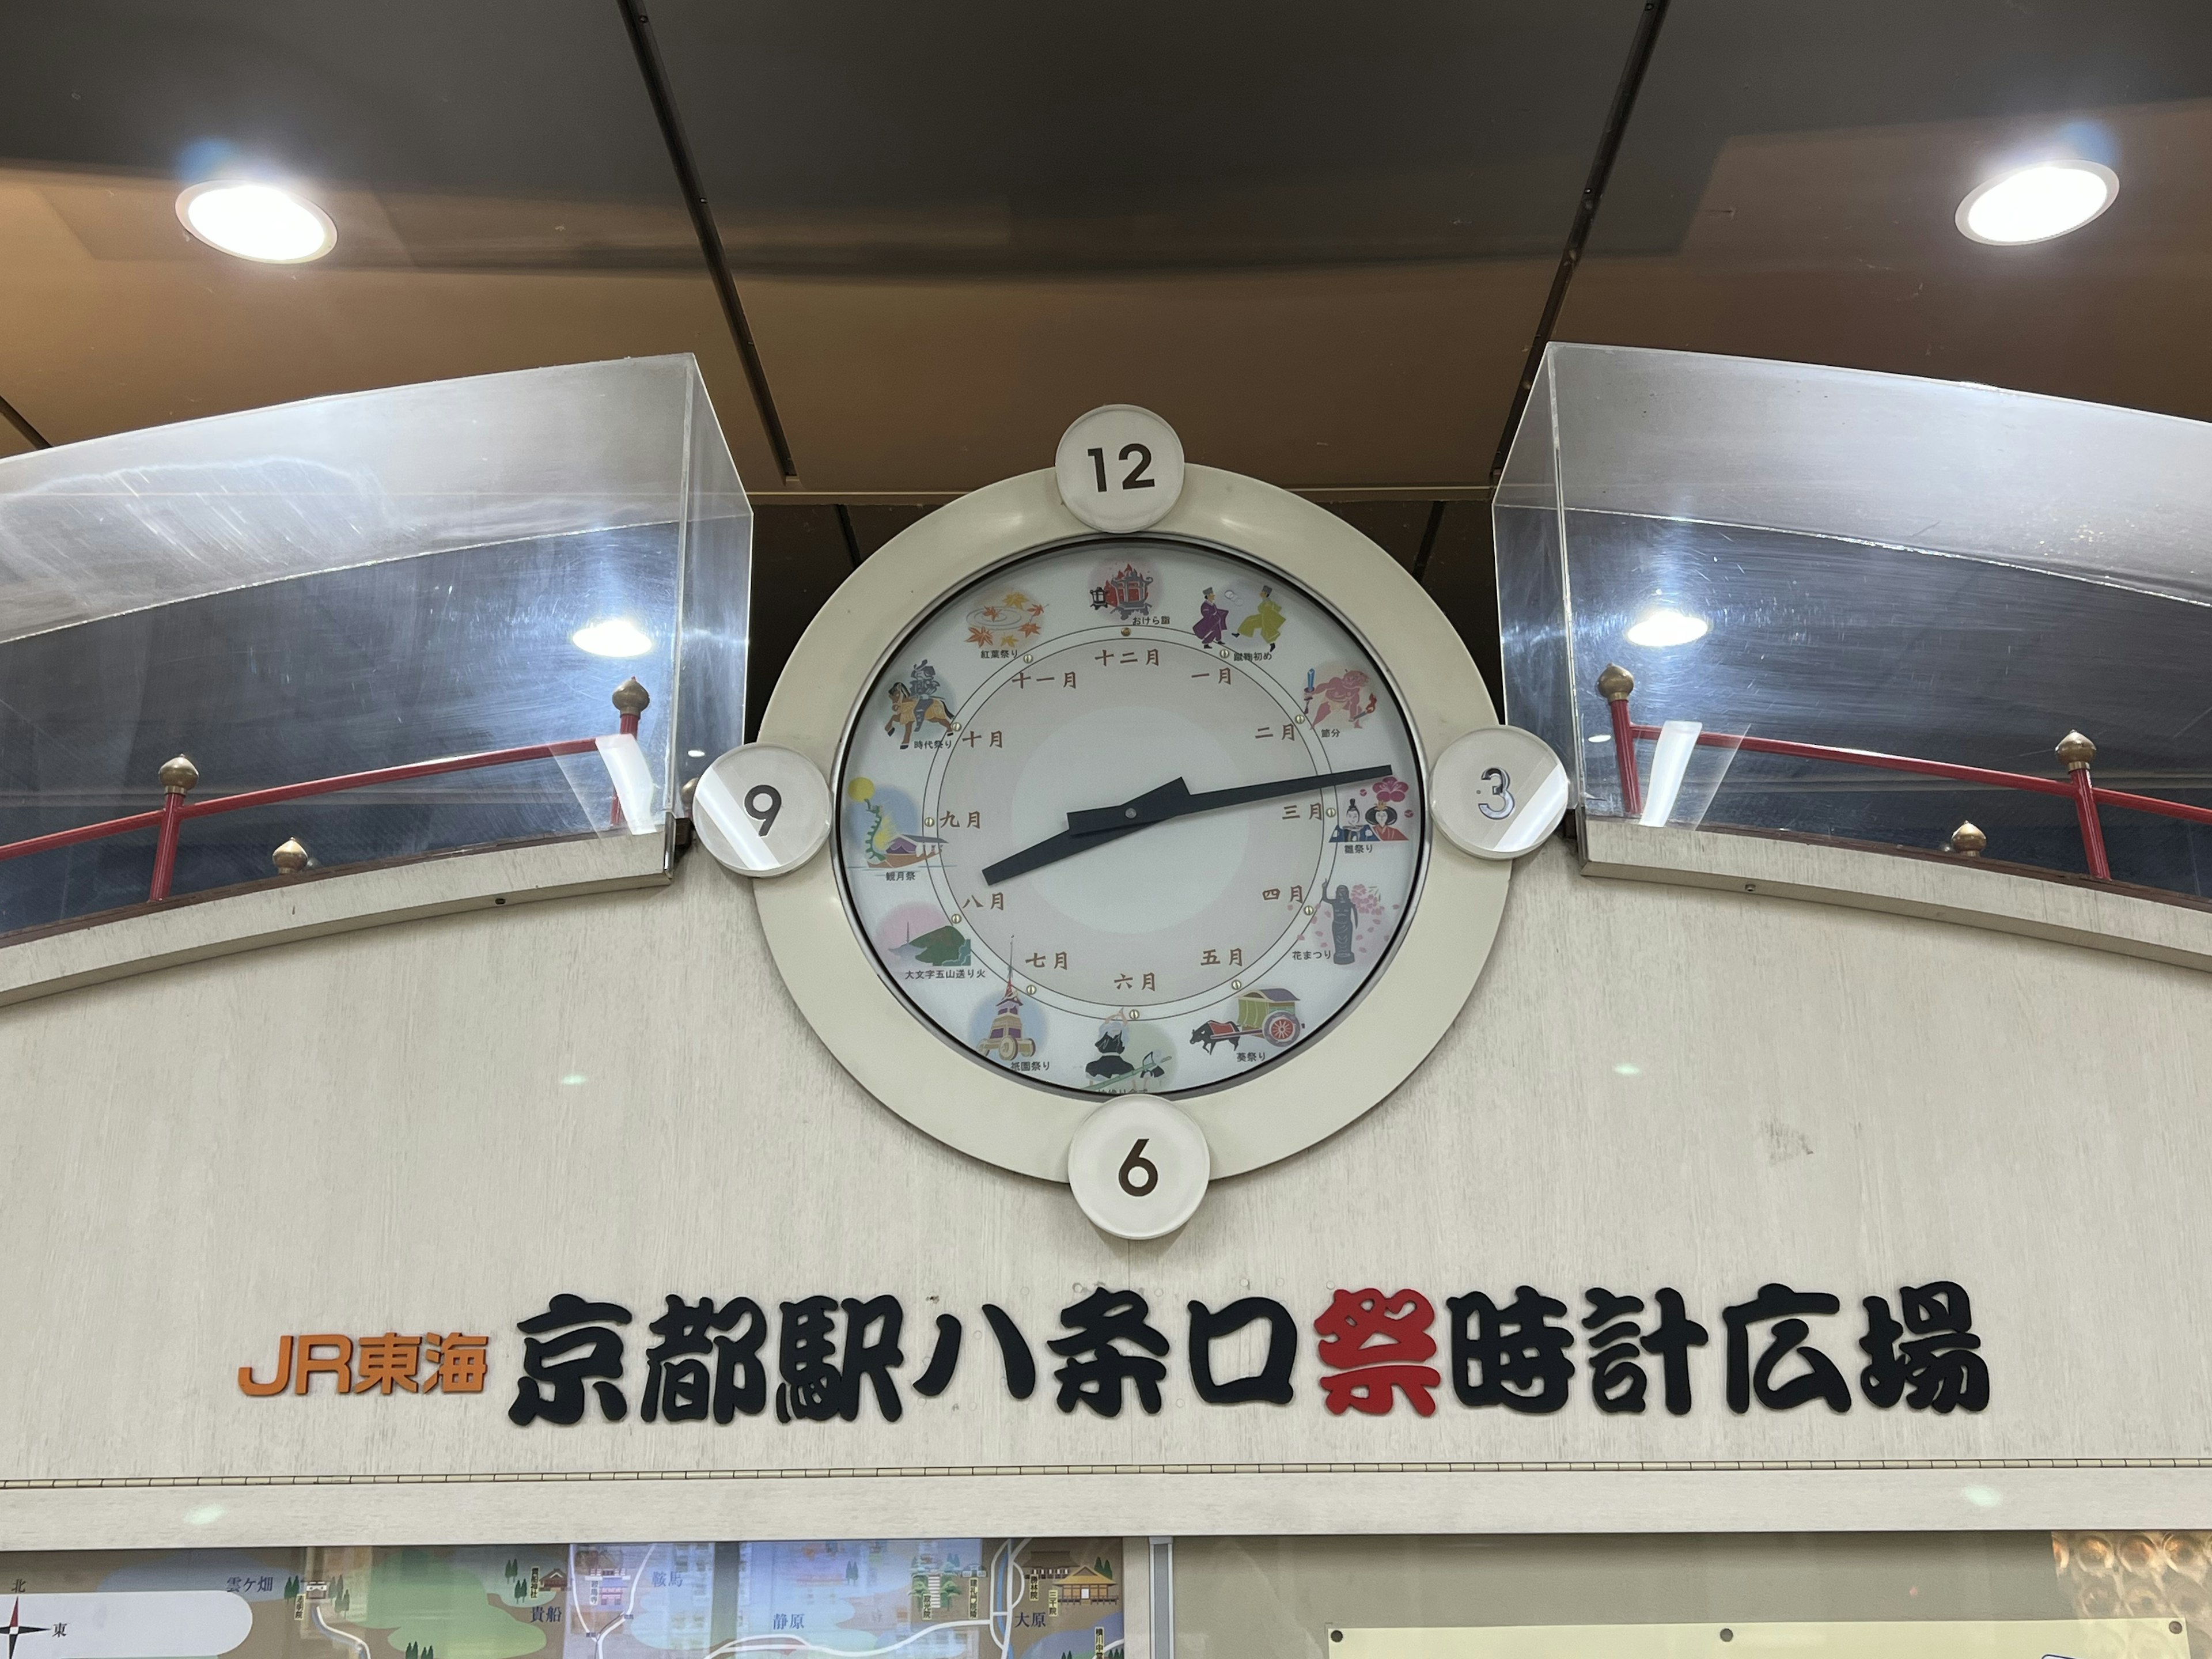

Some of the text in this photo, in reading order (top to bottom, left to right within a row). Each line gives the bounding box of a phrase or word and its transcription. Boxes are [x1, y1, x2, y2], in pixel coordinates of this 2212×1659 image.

[1088, 443, 1156, 493] 12
[980, 649, 1018, 659] 紅葉祭り
[1094, 649, 1159, 666] 十二月
[1012, 671, 1077, 690] 十一月
[1191, 667, 1232, 685] 一月
[961, 730, 1003, 749] 十月
[1255, 723, 1296, 741] 二月
[1321, 728, 1340, 738] 節分
[914, 739, 952, 749] 時代祭り
[1478, 766, 1516, 820] 3
[744, 784, 782, 837] 9
[1282, 802, 1323, 821] 三月
[940, 810, 981, 830] 九月
[1344, 844, 1373, 854] 雛祭り
[885, 871, 915, 881] 観月祭
[962, 892, 1004, 911] 八月
[1262, 885, 1304, 903] 四月
[1025, 951, 1068, 971] 七月
[1200, 948, 1243, 967] 五月
[1292, 949, 1332, 961] 花まつり
[905, 969, 986, 980] 大文字五山送り火
[1113, 972, 1156, 991] 六月
[1236, 1051, 1266, 1062] 葵祭り
[1118, 1138, 1158, 1197] 6
[237, 1282, 1990, 1427] JR東海 京都駅八条口祭時計広場
[11, 1578, 26, 1593] 北
[652, 1571, 683, 1588] 鞍馬
[1048, 1591, 1057, 1615] 三千院
[530, 1606, 562, 1623] 貴船
[772, 1613, 805, 1631] 静原
[1014, 1612, 1046, 1628] 大原
[52, 1622, 68, 1638] 東
